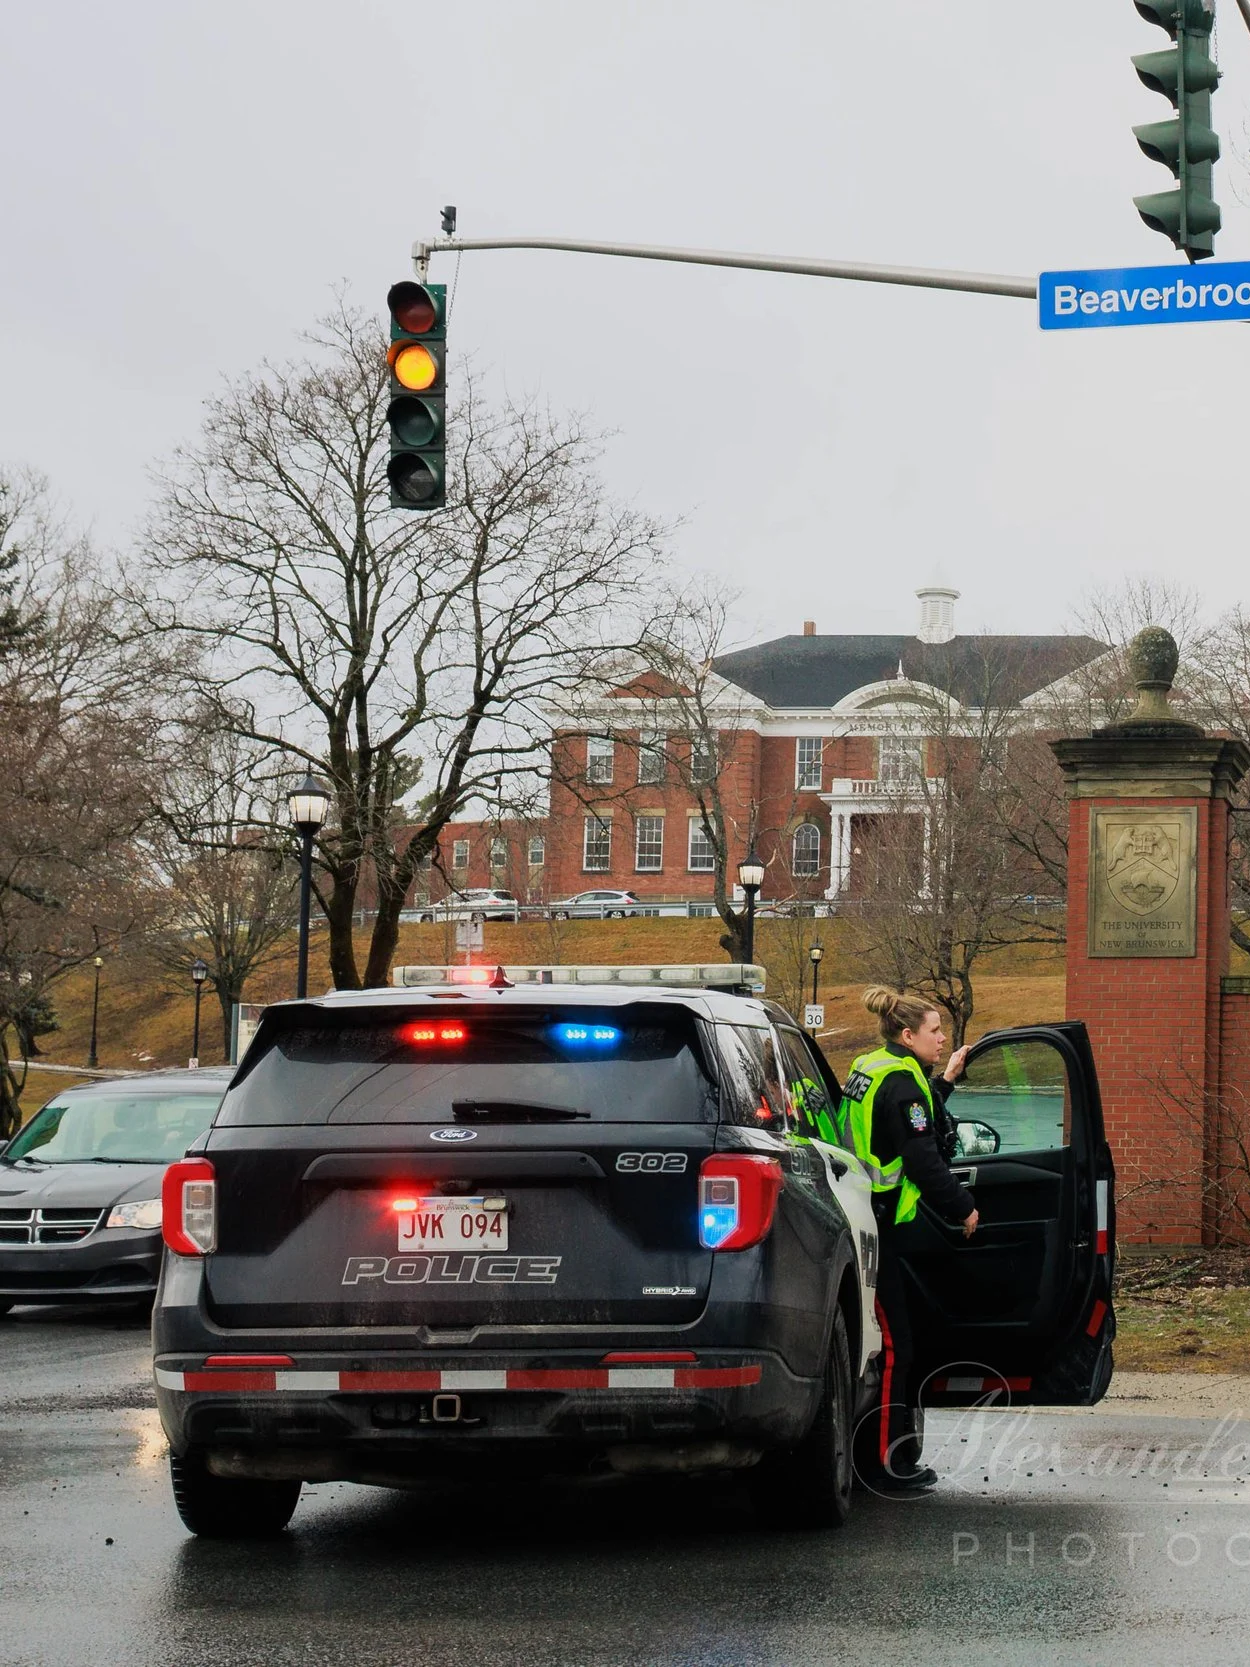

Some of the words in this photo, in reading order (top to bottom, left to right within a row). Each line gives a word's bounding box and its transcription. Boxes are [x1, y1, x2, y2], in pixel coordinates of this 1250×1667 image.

[849, 723, 914, 732] MEMORIAL
[1102, 921, 1121, 930] THE
[1124, 921, 1183, 930] UNIVERSITY
[1100, 940, 1122, 949] NEW
[1125, 940, 1184, 949] BRUNSWICK
[806, 1014, 822, 1025] 30
[615, 1152, 688, 1173] 302
[402, 1214, 444, 1239] JVK
[460, 1213, 503, 1239] 094
[341, 1256, 562, 1285] POLICE
